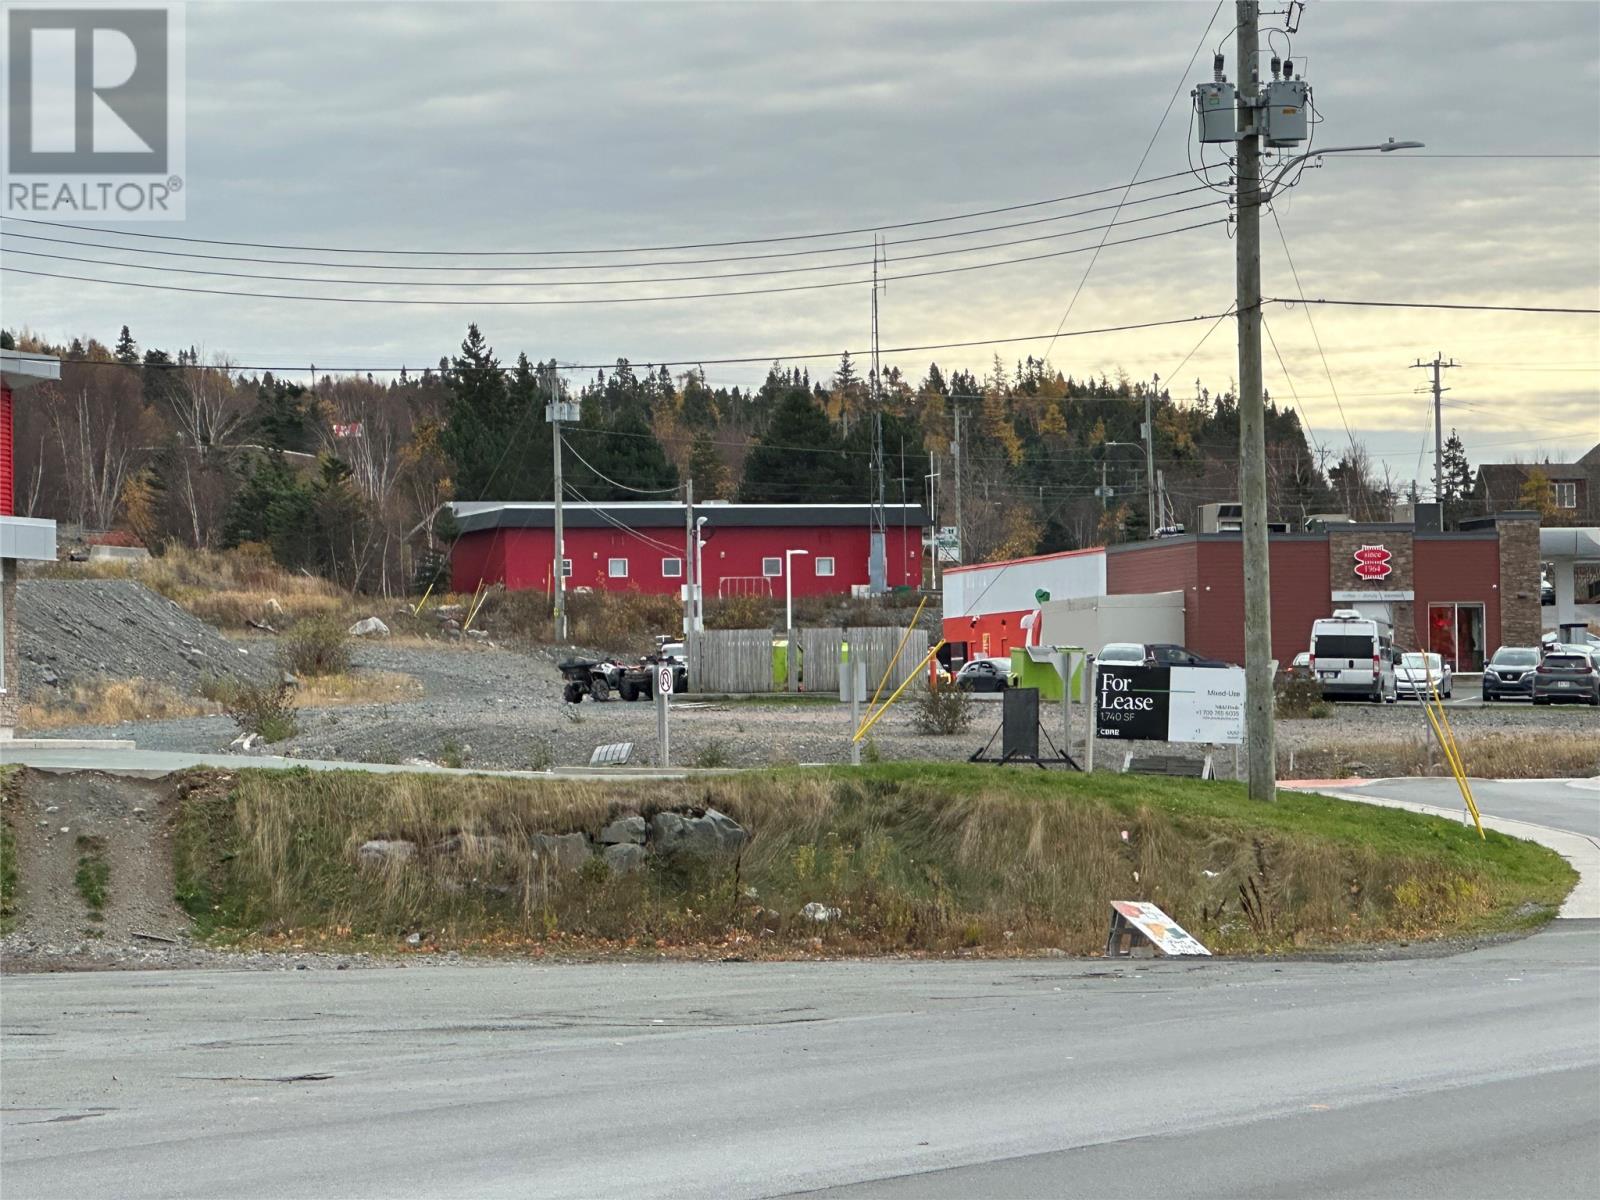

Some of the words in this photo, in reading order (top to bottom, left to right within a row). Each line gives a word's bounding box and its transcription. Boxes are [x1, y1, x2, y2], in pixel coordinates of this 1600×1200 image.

[1101, 673, 1132, 691] For
[1101, 691, 1154, 710] Lease
[1123, 713, 1135, 721] SF
